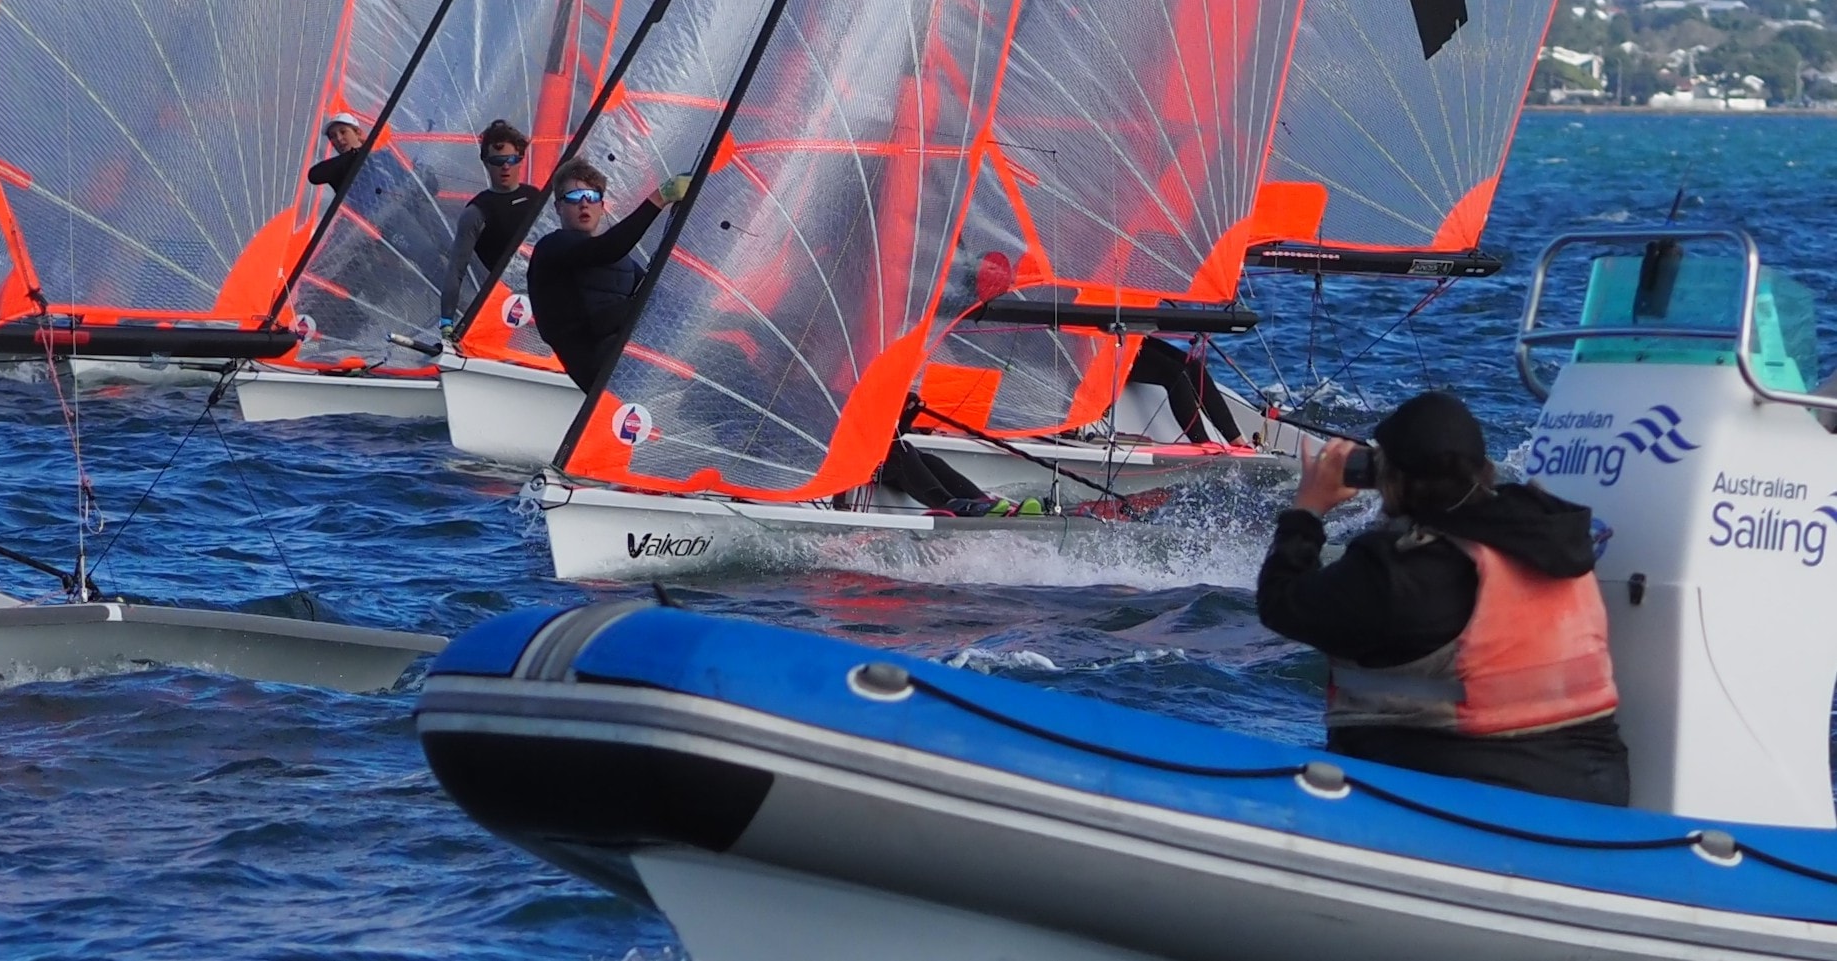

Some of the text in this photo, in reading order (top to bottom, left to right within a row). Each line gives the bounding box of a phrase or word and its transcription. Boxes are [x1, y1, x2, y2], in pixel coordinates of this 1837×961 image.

[1538, 411, 1614, 430] Australian
[1526, 436, 1626, 487] Sailing
[1712, 471, 1808, 501] Australian
[1709, 501, 1828, 567] Sailing
